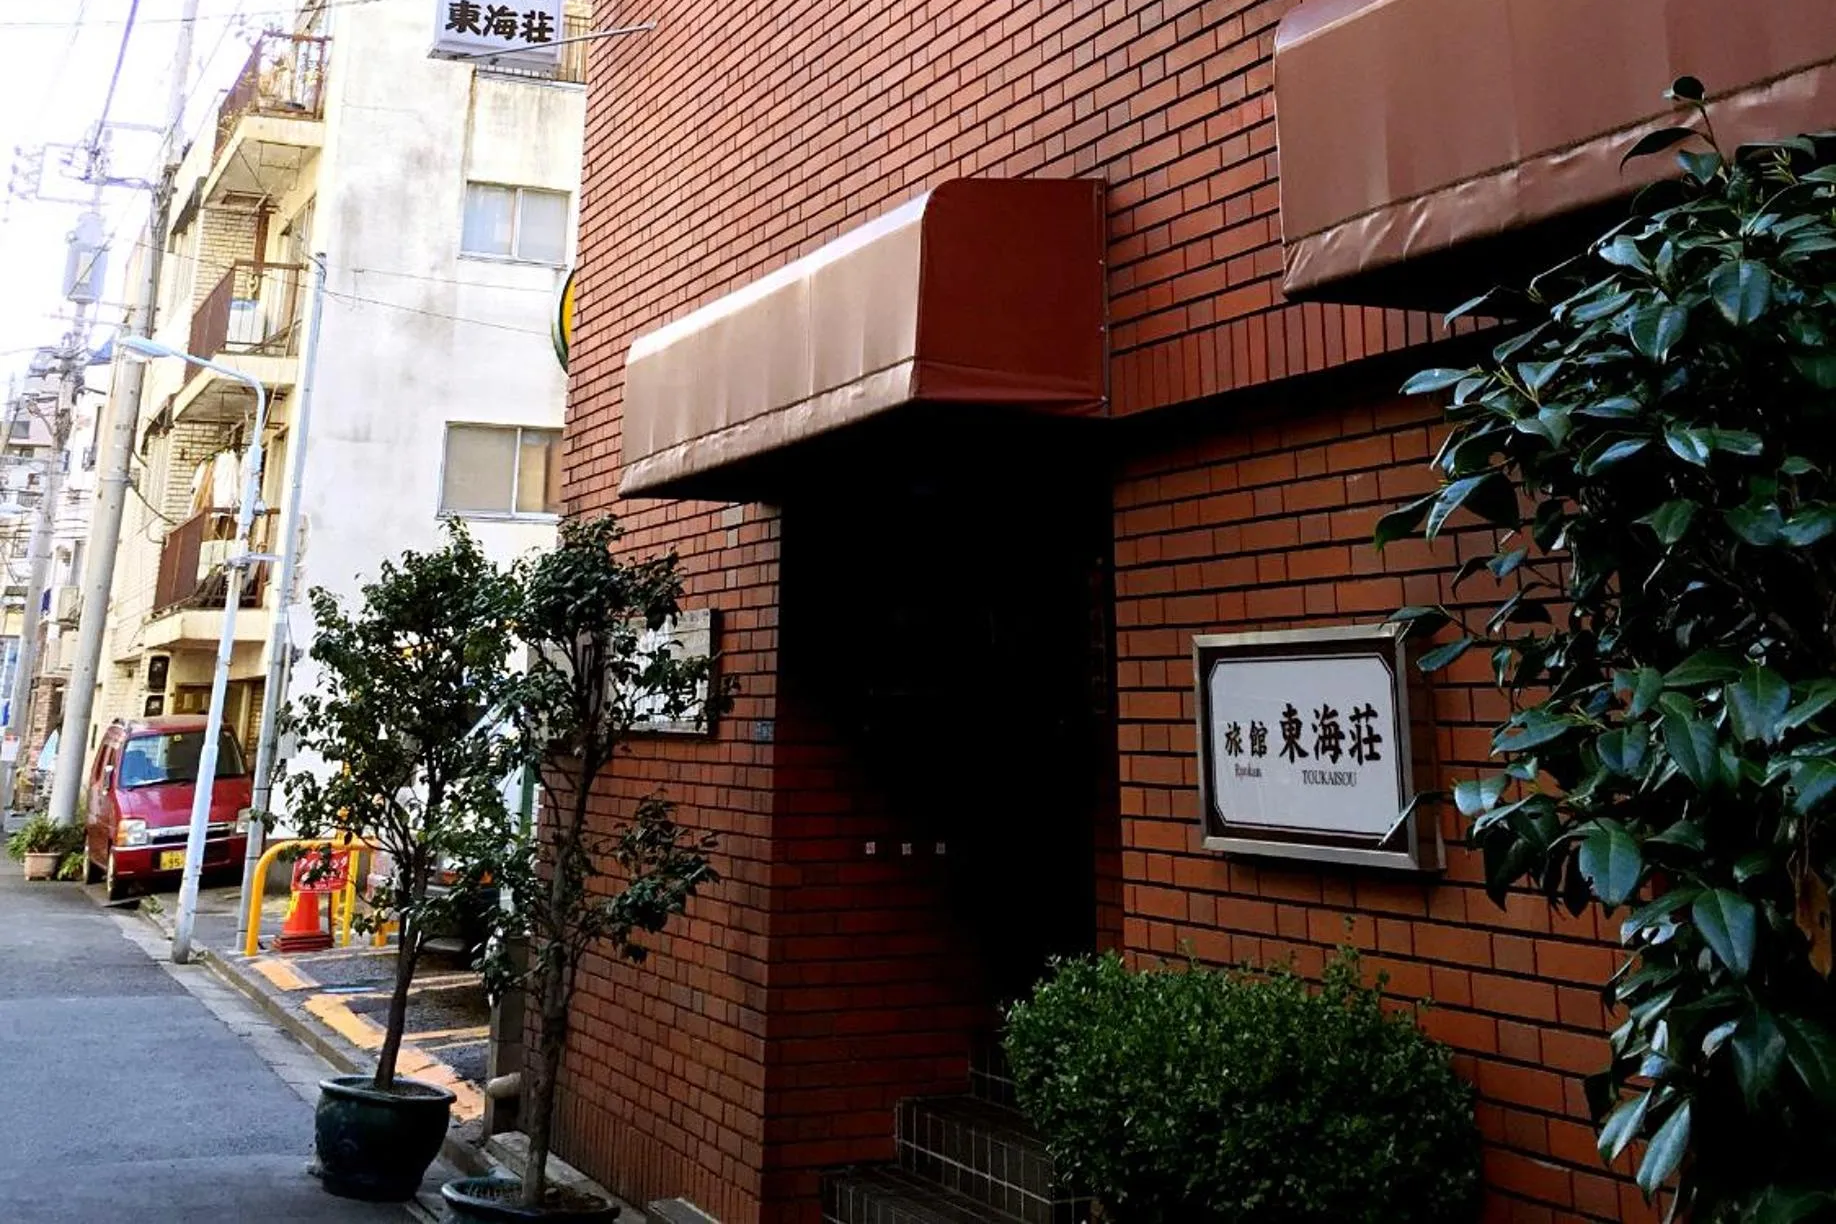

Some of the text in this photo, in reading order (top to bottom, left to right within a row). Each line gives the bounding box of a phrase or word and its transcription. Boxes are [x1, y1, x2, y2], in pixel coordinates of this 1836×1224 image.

[445, 0, 554, 44] 東海荘
[1224, 702, 1383, 766] 旅館 東海荘
[1302, 769, 1358, 788] TOUKAISOU
